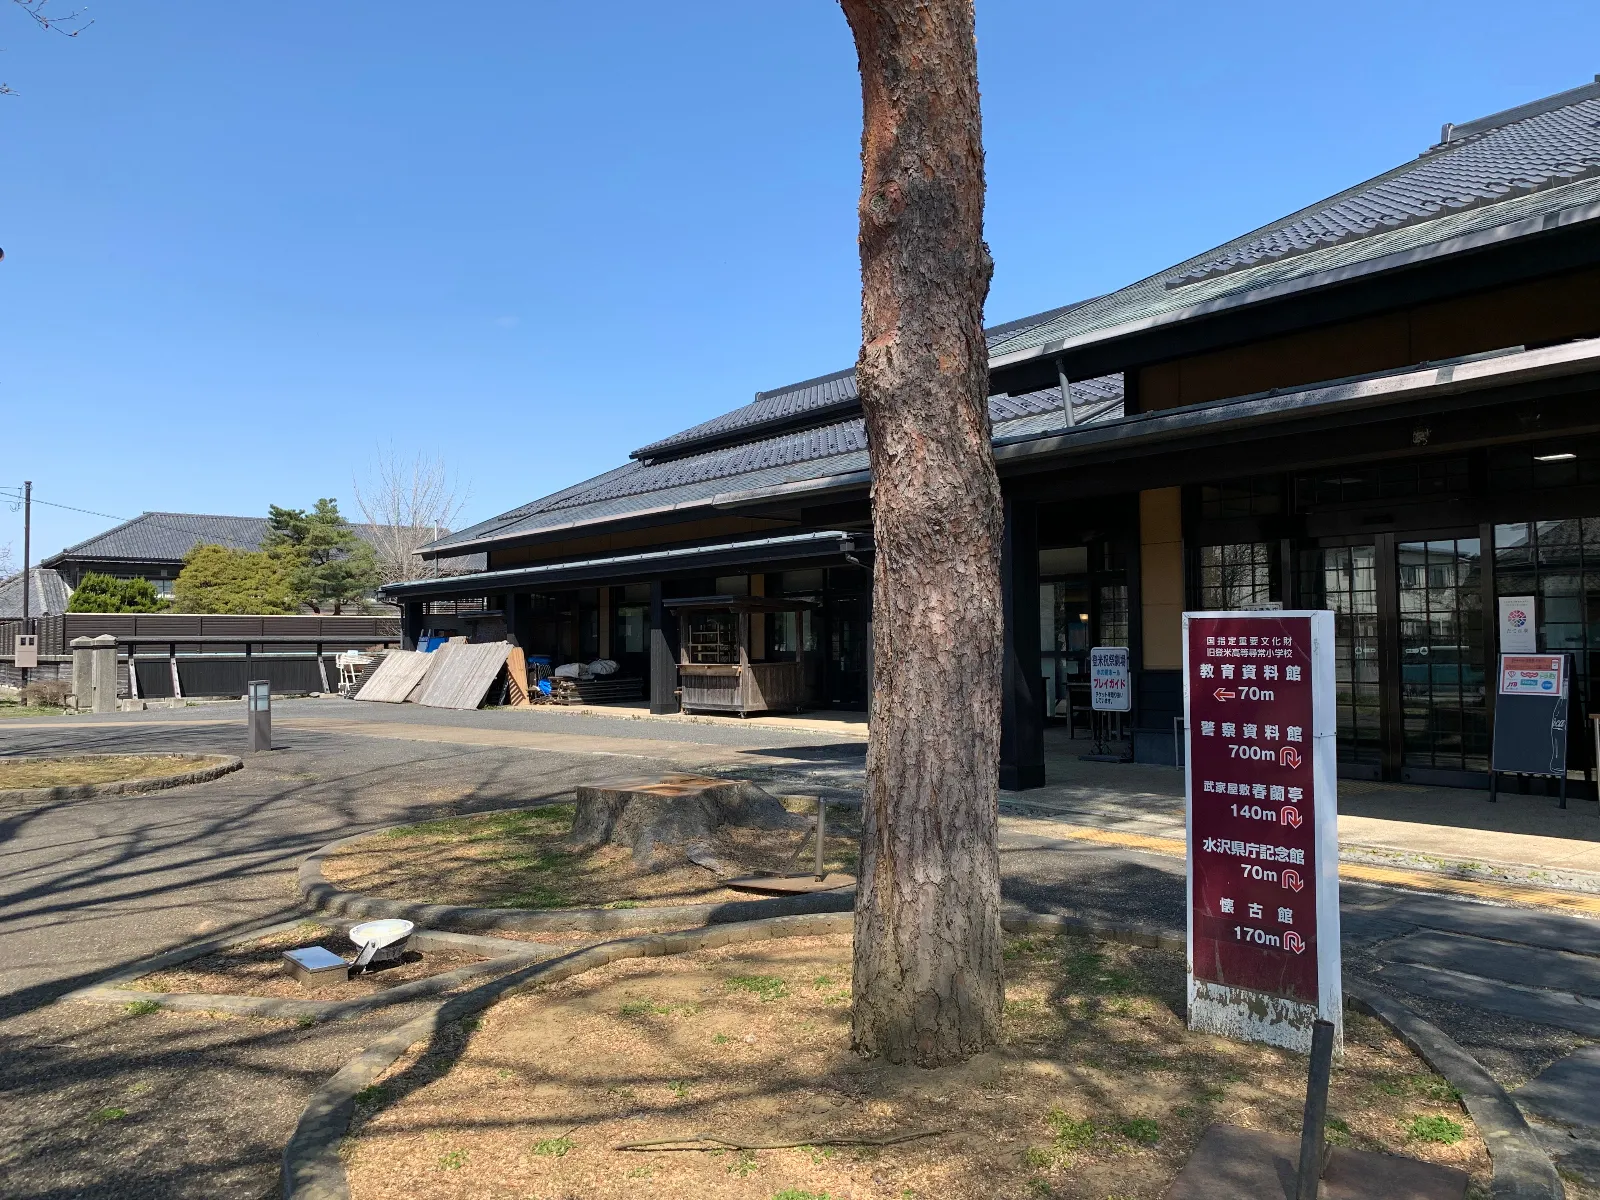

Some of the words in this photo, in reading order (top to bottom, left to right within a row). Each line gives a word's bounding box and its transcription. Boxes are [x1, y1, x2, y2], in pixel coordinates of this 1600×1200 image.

[1206, 636, 1292, 647] 国指定重要文化財
[1092, 654, 1126, 667] 登米祝祭劇場
[1206, 647, 1293, 658] 旧登米高等尋常小学校
[1199, 663, 1302, 682] 教育資料館
[1093, 678, 1126, 690] プレイガイド
[1238, 686, 1275, 701] 70m
[1200, 720, 1303, 743] 警察資料館
[1228, 744, 1276, 761] 700m
[1230, 803, 1277, 822] 140m
[1202, 836, 1305, 866] 水沢県庁記念館
[1240, 863, 1278, 883] 70m
[1219, 896, 1294, 926] 懐古館
[1233, 925, 1281, 948] 170m
